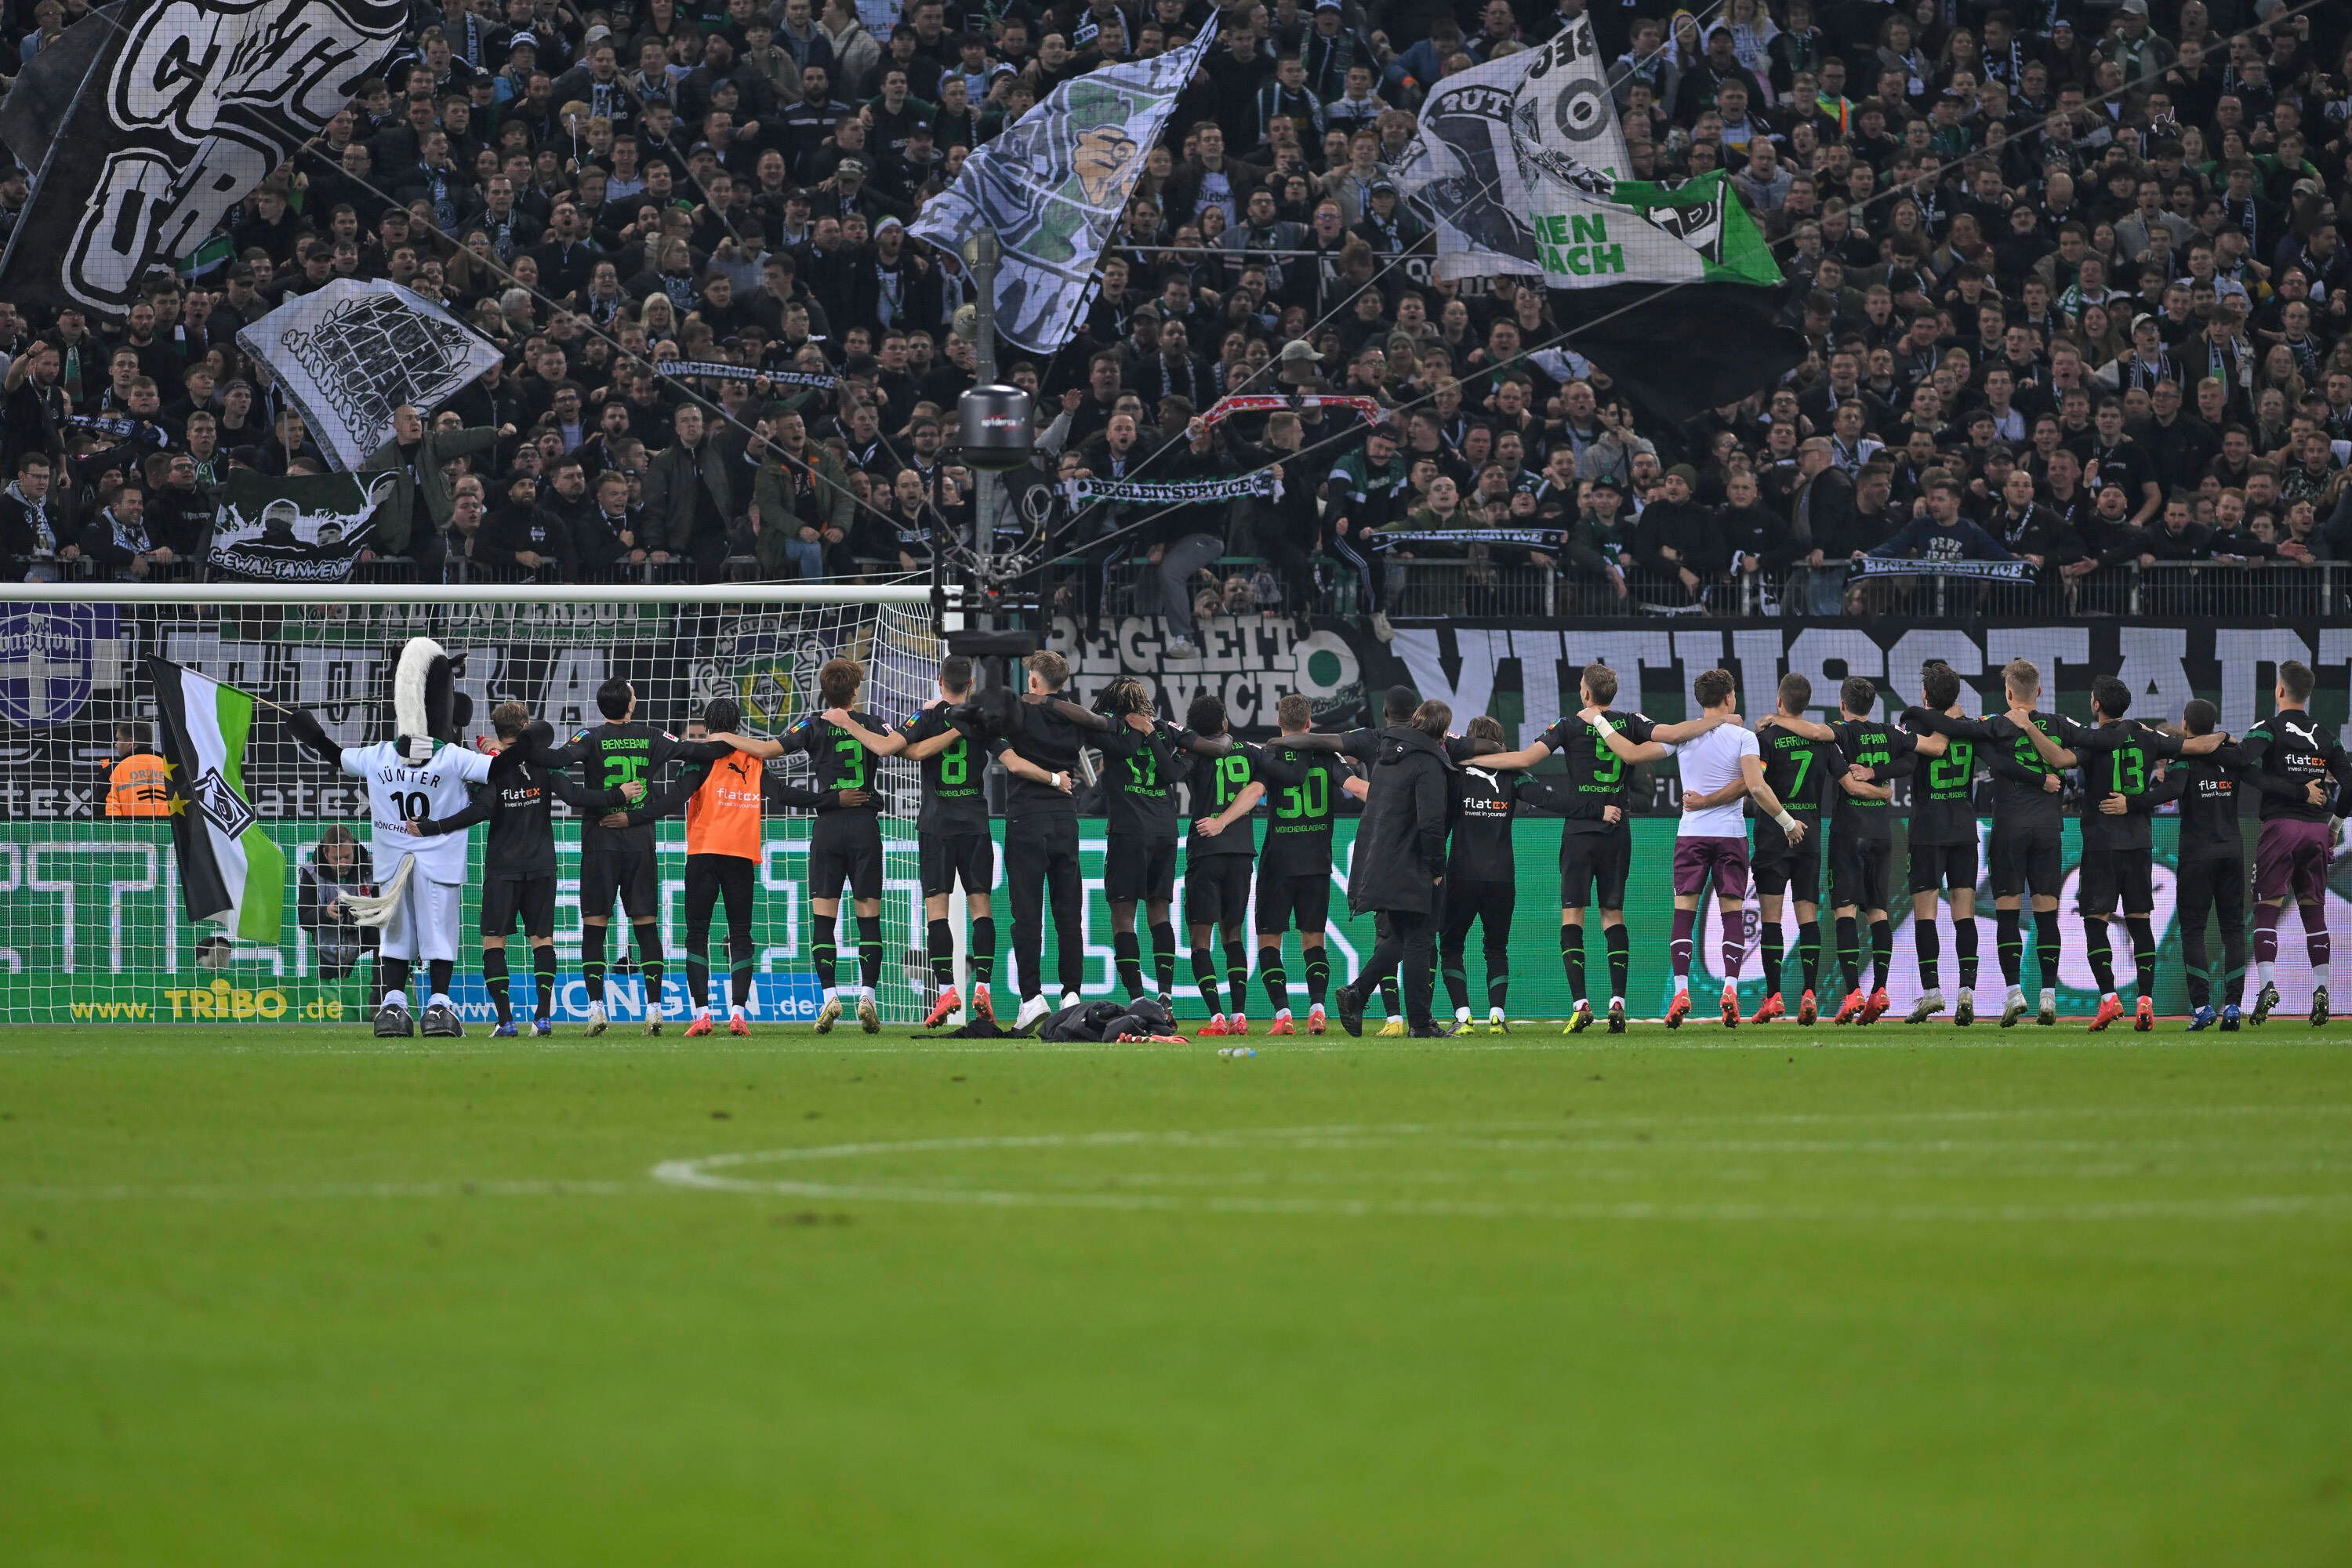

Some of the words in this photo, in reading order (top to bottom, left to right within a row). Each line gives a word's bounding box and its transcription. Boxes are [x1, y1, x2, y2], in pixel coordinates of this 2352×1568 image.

[1929, 537, 1963, 550] PEPE
[129, 769, 166, 782] ORDNE
[377, 766, 441, 789] JÜNTER
[603, 755, 650, 804] 25
[835, 739, 865, 789] 3
[942, 737, 967, 785] 8
[1215, 755, 1250, 806] 19
[1788, 750, 1813, 799] 7
[1930, 740, 1973, 789] 29
[2112, 746, 2145, 796] 13
[389, 790, 430, 822] 10
[1276, 766, 1329, 818] 30
